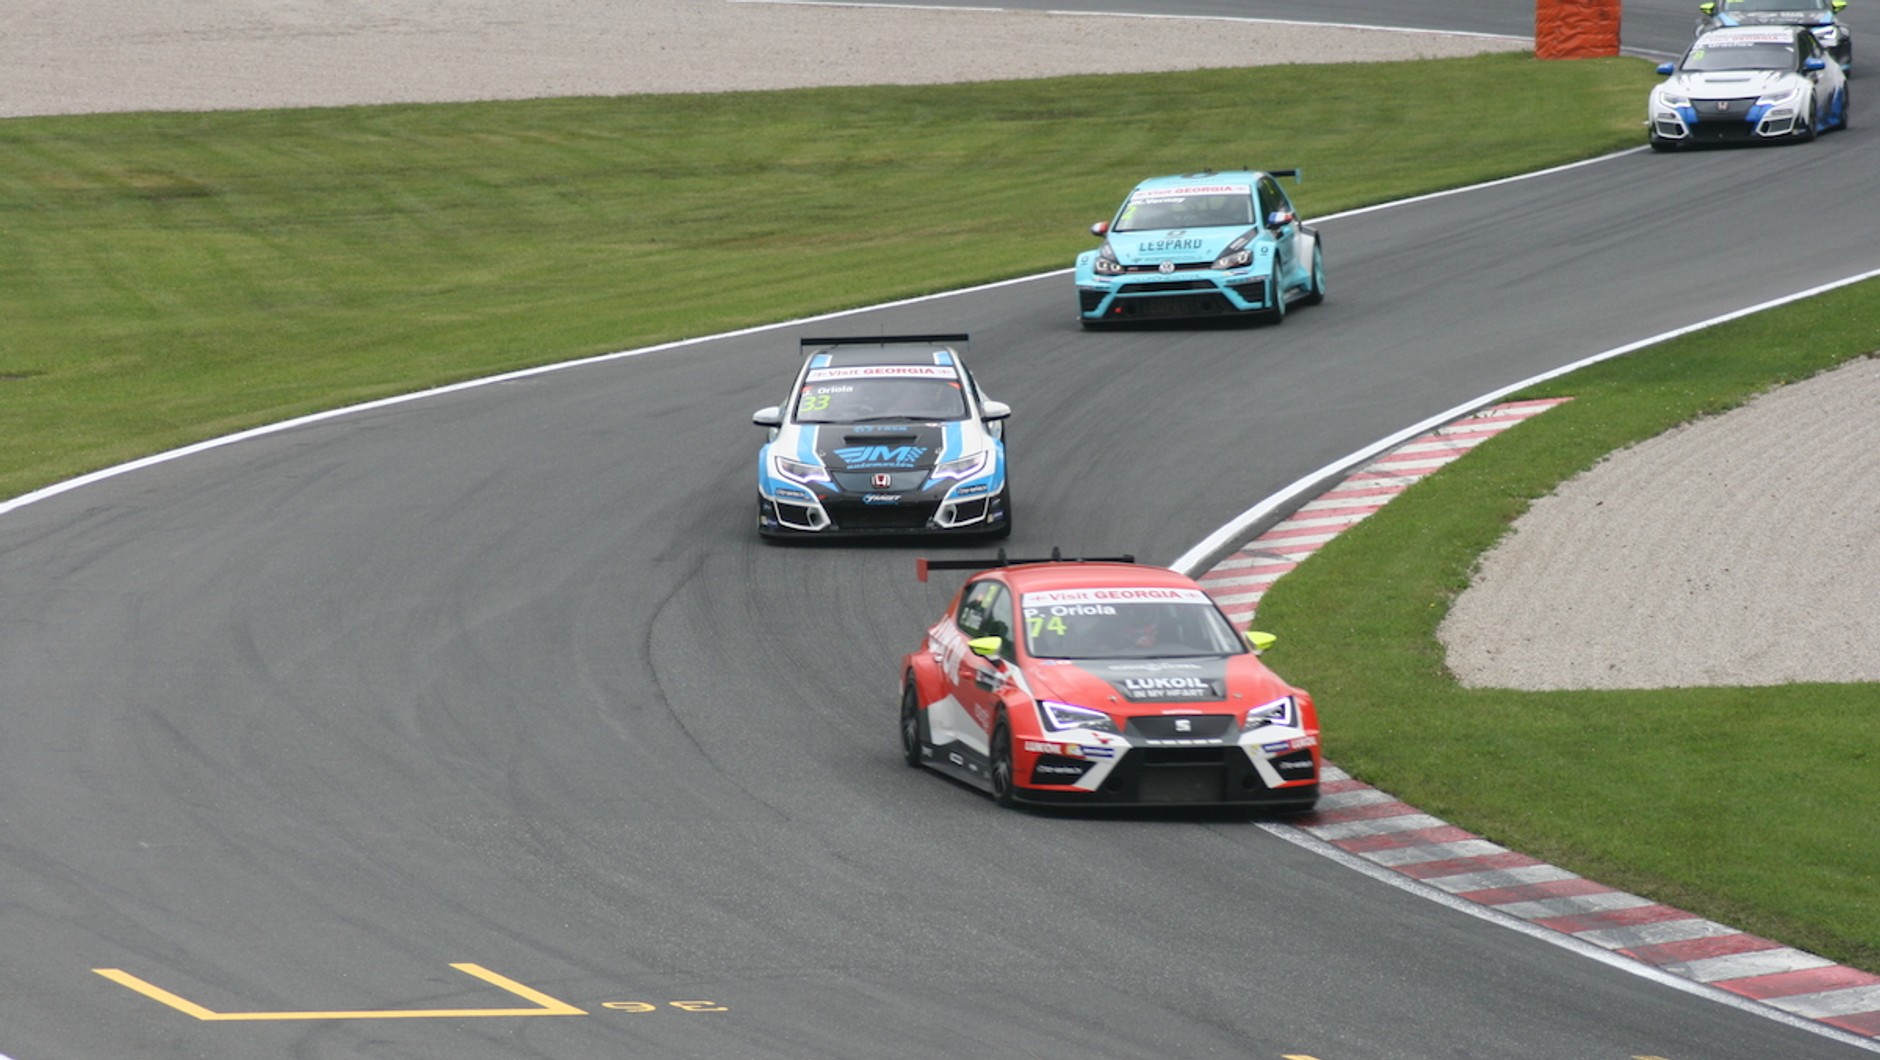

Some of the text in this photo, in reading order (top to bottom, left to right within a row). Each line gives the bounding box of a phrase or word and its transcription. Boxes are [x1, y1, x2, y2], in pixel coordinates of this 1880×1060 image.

[1121, 206, 1137, 220] 2
[1140, 240, 1202, 251] LEOPARD
[818, 385, 853, 394] Oriola
[801, 395, 830, 412] 33
[1050, 590, 1181, 601] Visit GEORGIA
[1024, 605, 1116, 618] P. Oriola
[1026, 617, 1066, 637] 74
[1125, 678, 1208, 690] LUKOIL
[1167, 688, 1205, 697] HEART
